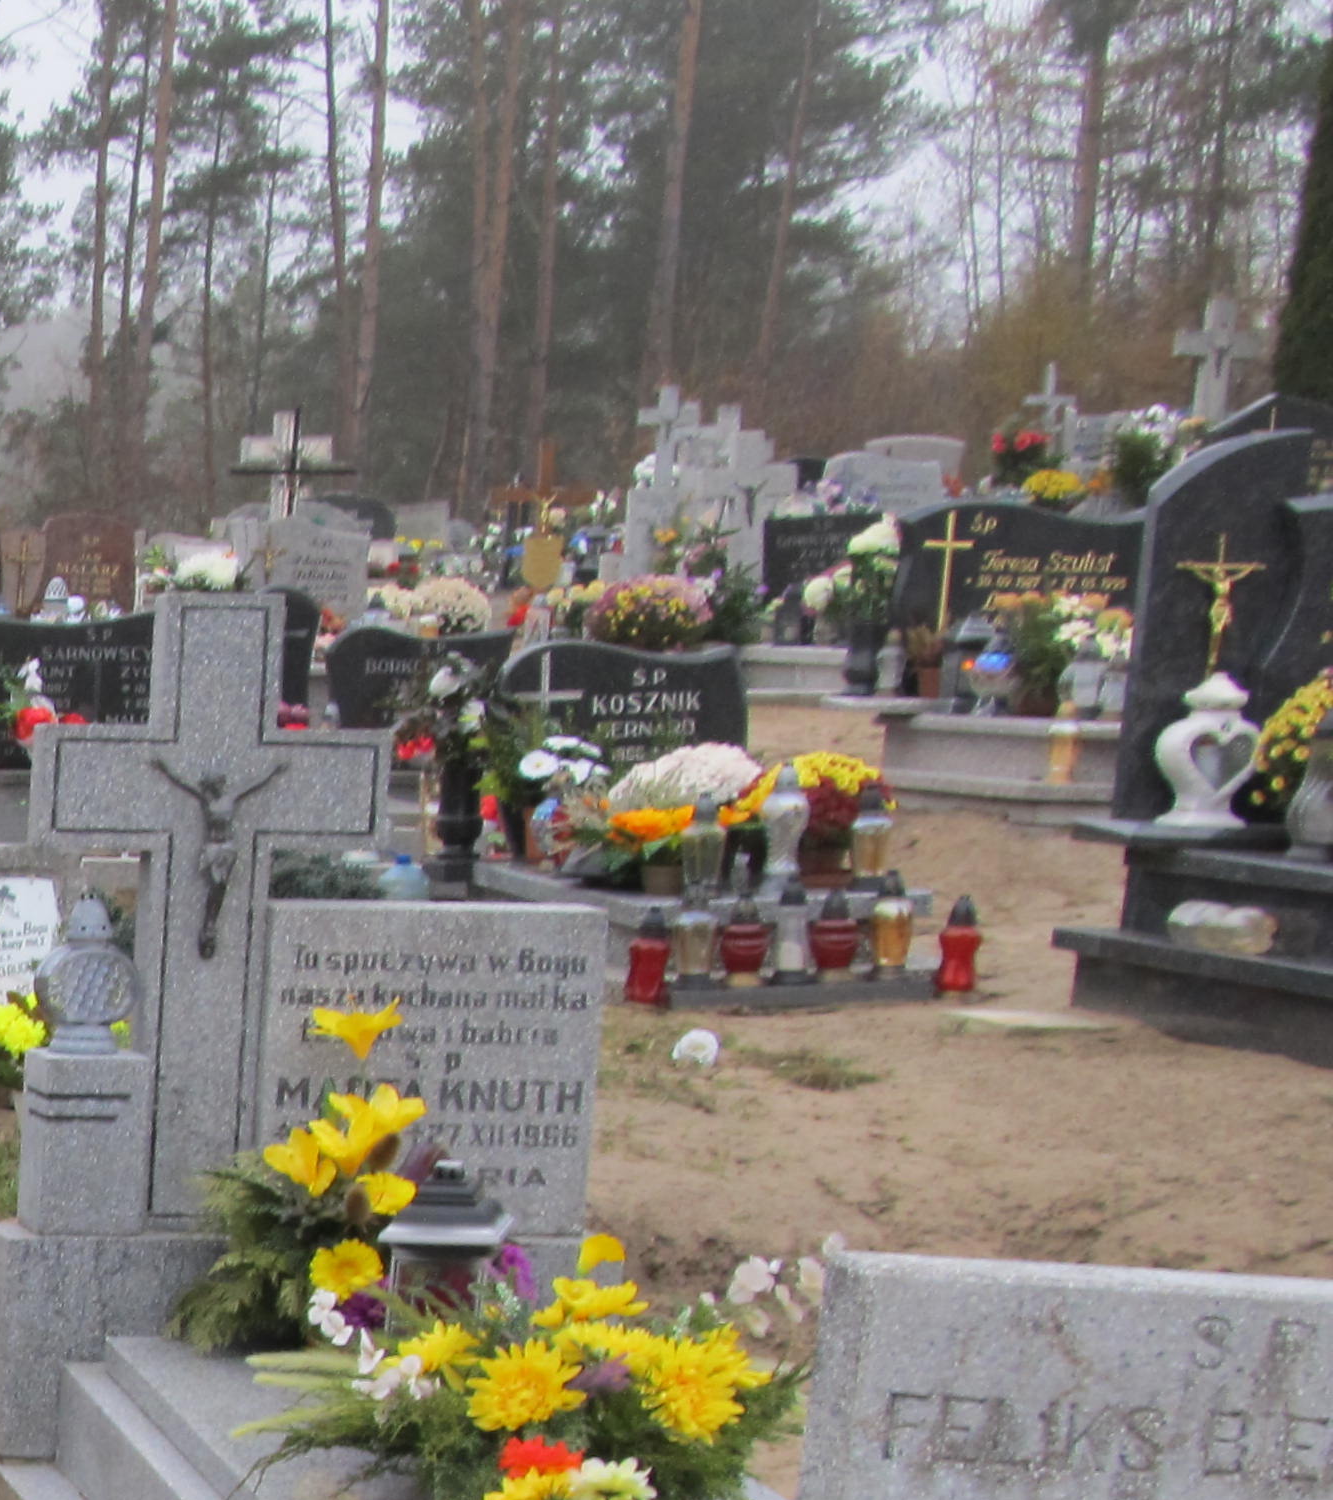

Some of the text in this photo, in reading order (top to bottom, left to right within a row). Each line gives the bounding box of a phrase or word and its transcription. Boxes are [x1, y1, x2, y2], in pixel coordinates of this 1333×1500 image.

[981, 550, 1118, 573] Teresa Szulist
[591, 690, 702, 716] KOSZNIK
[326, 952, 477, 976] spoczywa
[487, 953, 510, 972] w
[517, 949, 588, 979] Bogu
[437, 1078, 586, 1115] KNUTH
[880, 1391, 1167, 1474] FELIKS
